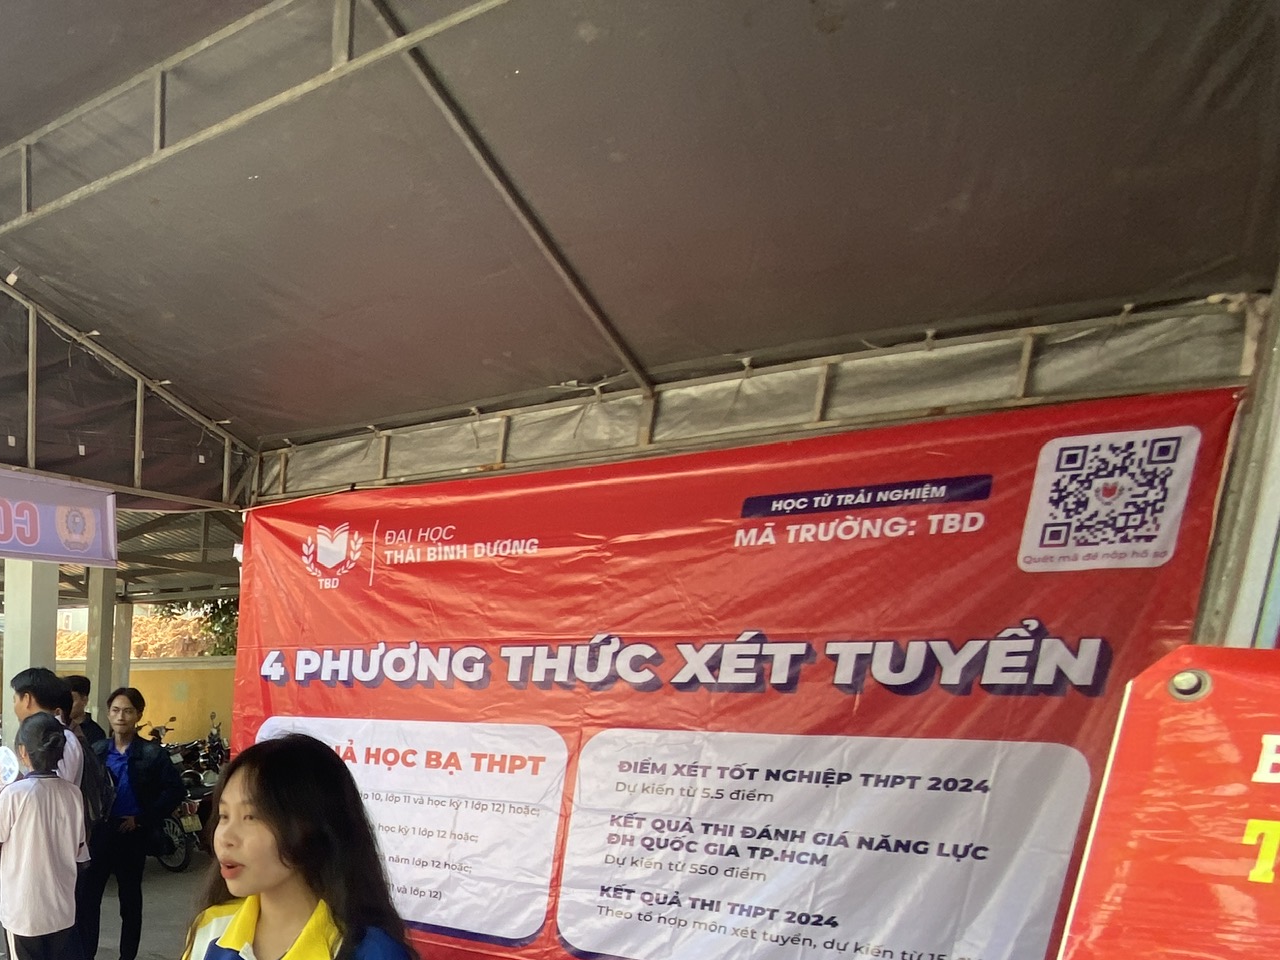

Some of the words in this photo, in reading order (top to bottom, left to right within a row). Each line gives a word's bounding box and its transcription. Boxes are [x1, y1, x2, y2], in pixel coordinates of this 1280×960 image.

[771, 497, 808, 513] HỌC
[814, 494, 833, 507] TỪ
[837, 488, 871, 506] TRẢI
[876, 483, 946, 502] NGHIỆM
[384, 529, 411, 546] ĐẠI
[417, 525, 456, 545] HỌC
[734, 523, 776, 547] MÃ
[786, 515, 916, 543] TRƯỜNG:
[927, 512, 985, 535] TBD
[384, 546, 420, 565] THÁI
[427, 542, 467, 562] BÌNH
[474, 538, 539, 558] DƯƠNG
[318, 578, 339, 589] TBD
[260, 649, 285, 682] 4
[295, 641, 486, 683] PHƯƠNG
[500, 634, 661, 685] THỨC
[670, 632, 807, 686] XÉT
[825, 618, 1102, 687] TUYỂN
[365, 747, 417, 771] HỌC
[425, 751, 462, 775] BẠ
[471, 753, 546, 775] THPT
[618, 757, 667, 776] ĐIỂM
[673, 761, 711, 778] XÉT
[717, 762, 759, 781] TỐT
[765, 768, 852, 788] NGHIỆP
[860, 773, 921, 790] THPT
[927, 777, 990, 793] 2024
[371, 792, 383, 802] 10,
[385, 793, 400, 804] lớp
[403, 795, 410, 803] 11
[413, 796, 425, 805] và
[428, 797, 446, 808] học
[471, 800, 488, 813] lớp
[491, 802, 505, 815] 12)
[615, 781, 637, 795] Dự
[641, 783, 674, 797] kiến
[679, 785, 698, 797] từ
[701, 788, 724, 800] 5.5
[730, 787, 774, 802] điểm
[378, 822, 395, 834] học
[418, 827, 434, 839] lớp
[437, 829, 447, 839] 12
[610, 812, 646, 829] KẾT
[651, 817, 694, 834] QUẢ
[701, 822, 735, 837] THI
[740, 824, 806, 844] ĐÁNH
[812, 831, 850, 848] GIÁ
[857, 834, 929, 855] NĂNG
[936, 842, 990, 862] LỰC
[412, 857, 428, 868] lớp
[431, 860, 441, 869] 12
[607, 833, 635, 847] ĐH
[640, 835, 698, 853] QUỐC
[704, 842, 740, 858] GIA
[747, 846, 829, 867] TP.HCM
[604, 854, 626, 868] Dự
[631, 856, 663, 871] kiến
[689, 863, 719, 876] 550
[410, 886, 426, 898] lớp
[428, 889, 442, 901] 12)
[600, 883, 635, 900] KẾT
[640, 891, 682, 908] QUẢ
[688, 896, 721, 913] THI
[727, 901, 779, 921] THPT
[784, 911, 839, 928] 2024
[597, 905, 632, 920] Theo
[637, 908, 653, 922] tổ
[658, 912, 687, 928] hợp
[693, 919, 727, 935] môn
[732, 925, 756, 939] xét
[763, 930, 817, 949] tuyển,
[823, 938, 849, 954] dự
[854, 941, 893, 959] kiến
